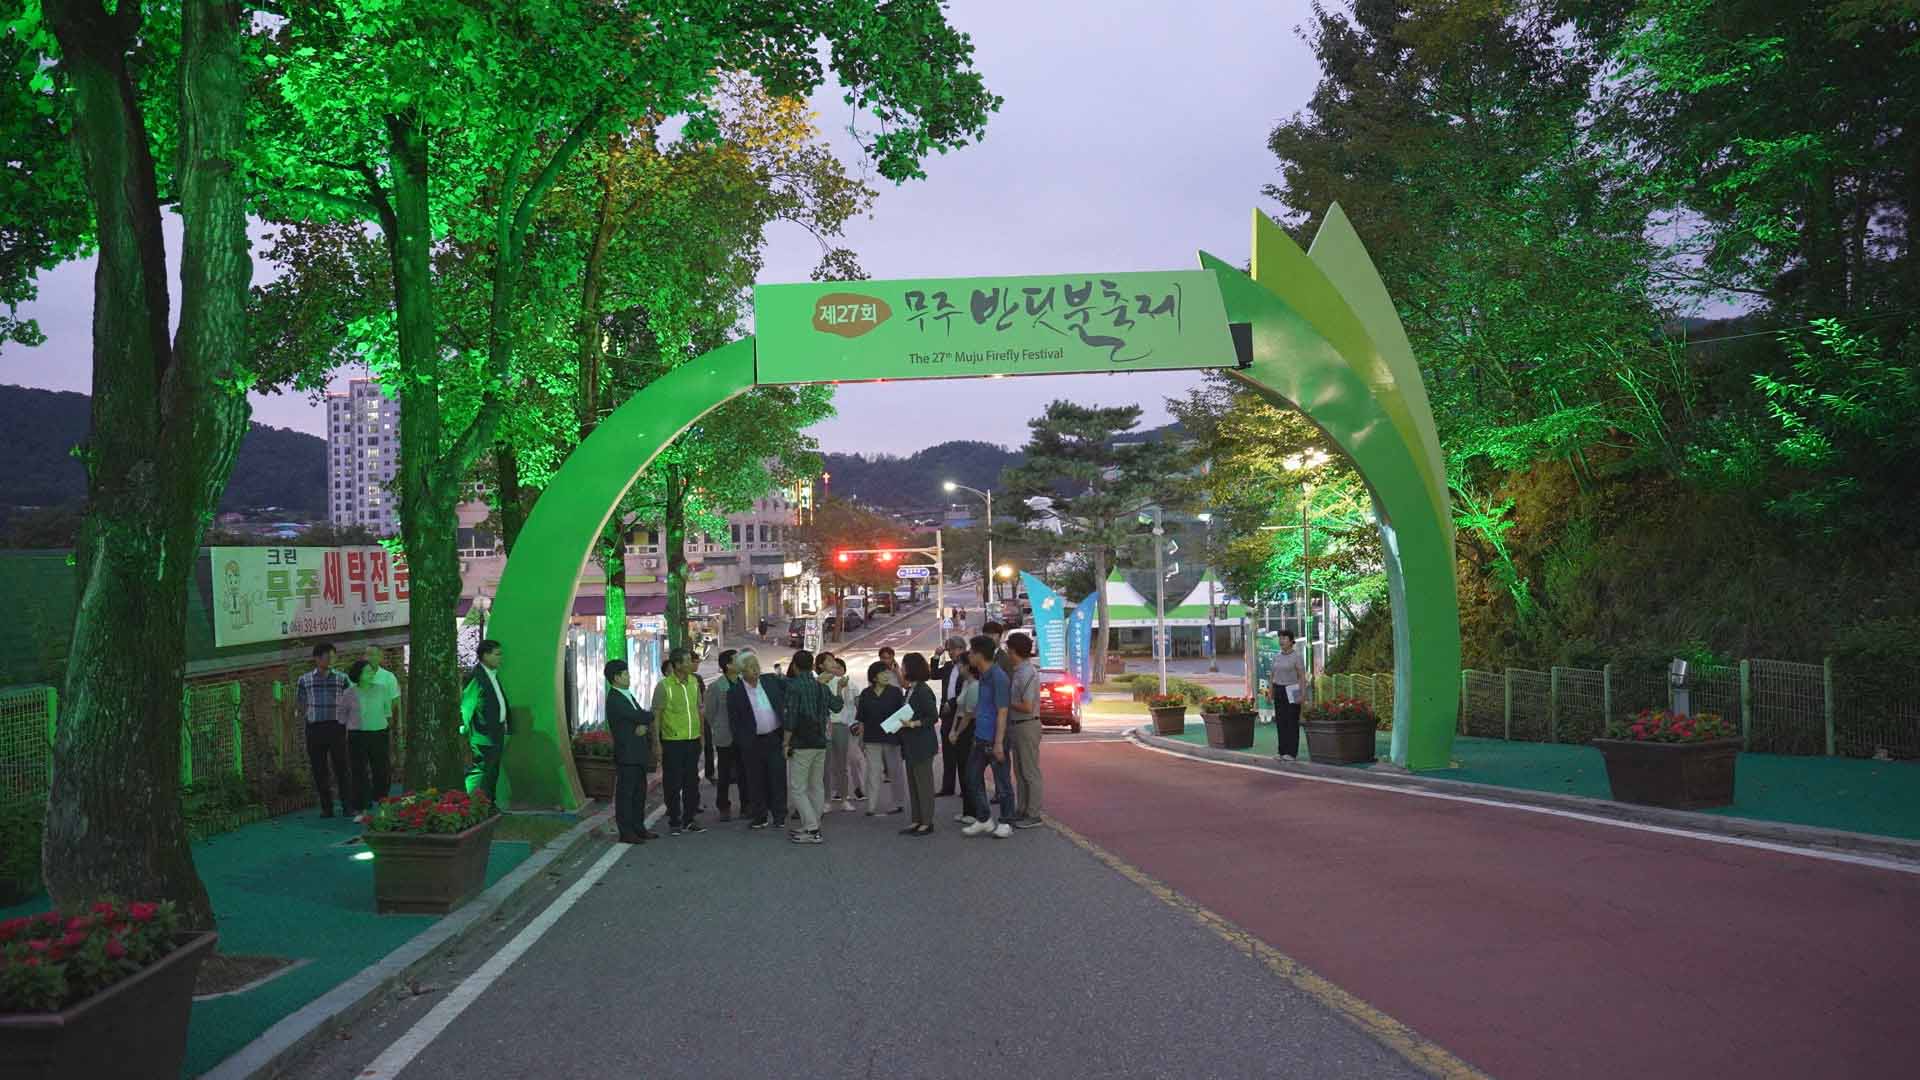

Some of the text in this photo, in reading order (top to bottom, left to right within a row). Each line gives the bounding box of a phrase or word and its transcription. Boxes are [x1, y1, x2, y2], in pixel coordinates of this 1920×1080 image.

[819, 303, 878, 325] 제27회
[904, 290, 964, 336] 무주
[908, 347, 1064, 365] The 27th Muju Firefly Festival
[267, 549, 297, 565] 크린
[267, 569, 320, 612] 무주
